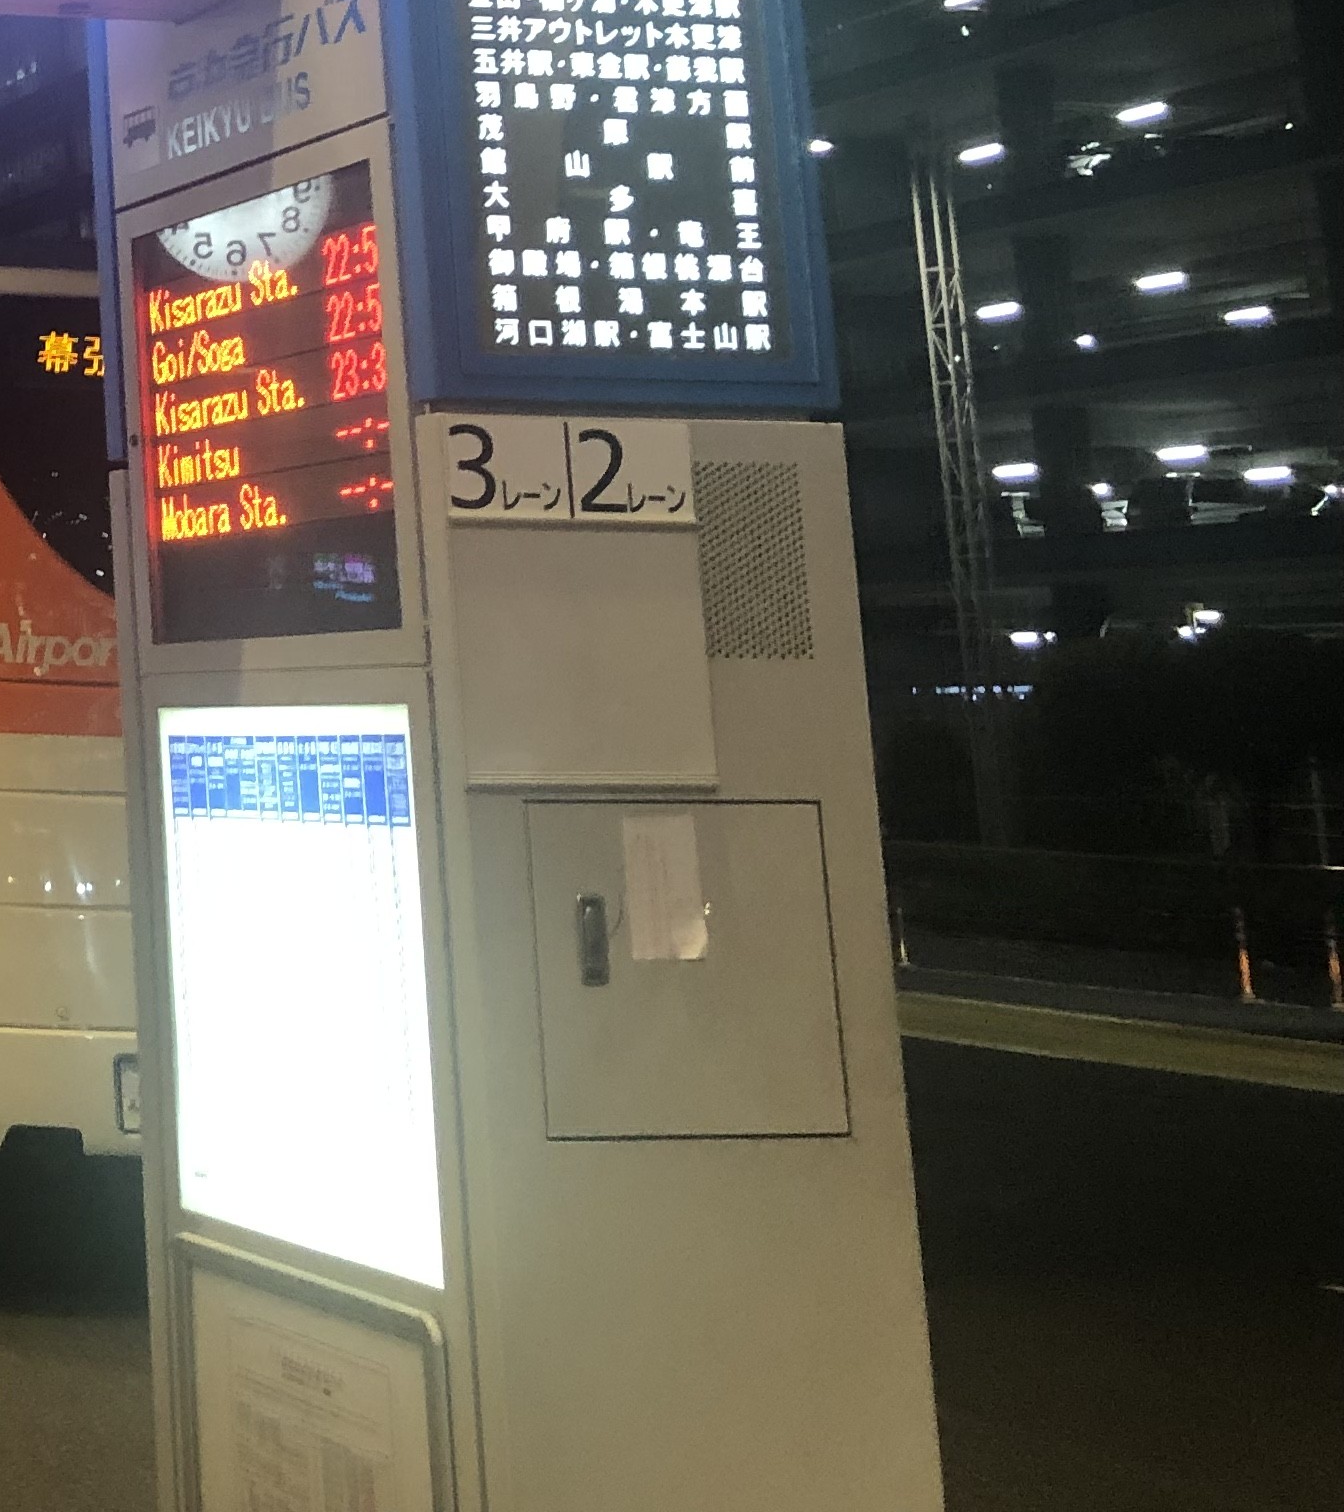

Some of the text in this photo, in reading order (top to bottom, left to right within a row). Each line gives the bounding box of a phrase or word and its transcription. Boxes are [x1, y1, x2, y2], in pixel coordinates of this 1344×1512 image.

[168, 97, 252, 160] KEIKYU
[149, 281, 243, 336] Kisarazu
[248, 259, 300, 307] Sta.
[151, 328, 246, 386] Goi/Soga
[154, 386, 249, 437] Kisarazu
[256, 369, 305, 414] Sta.
[157, 438, 240, 488] Kimitsu
[448, 423, 561, 511] 3レーン
[578, 428, 686, 514] 2レーン
[161, 492, 232, 543] Mobara
[239, 483, 287, 529] Sta.
